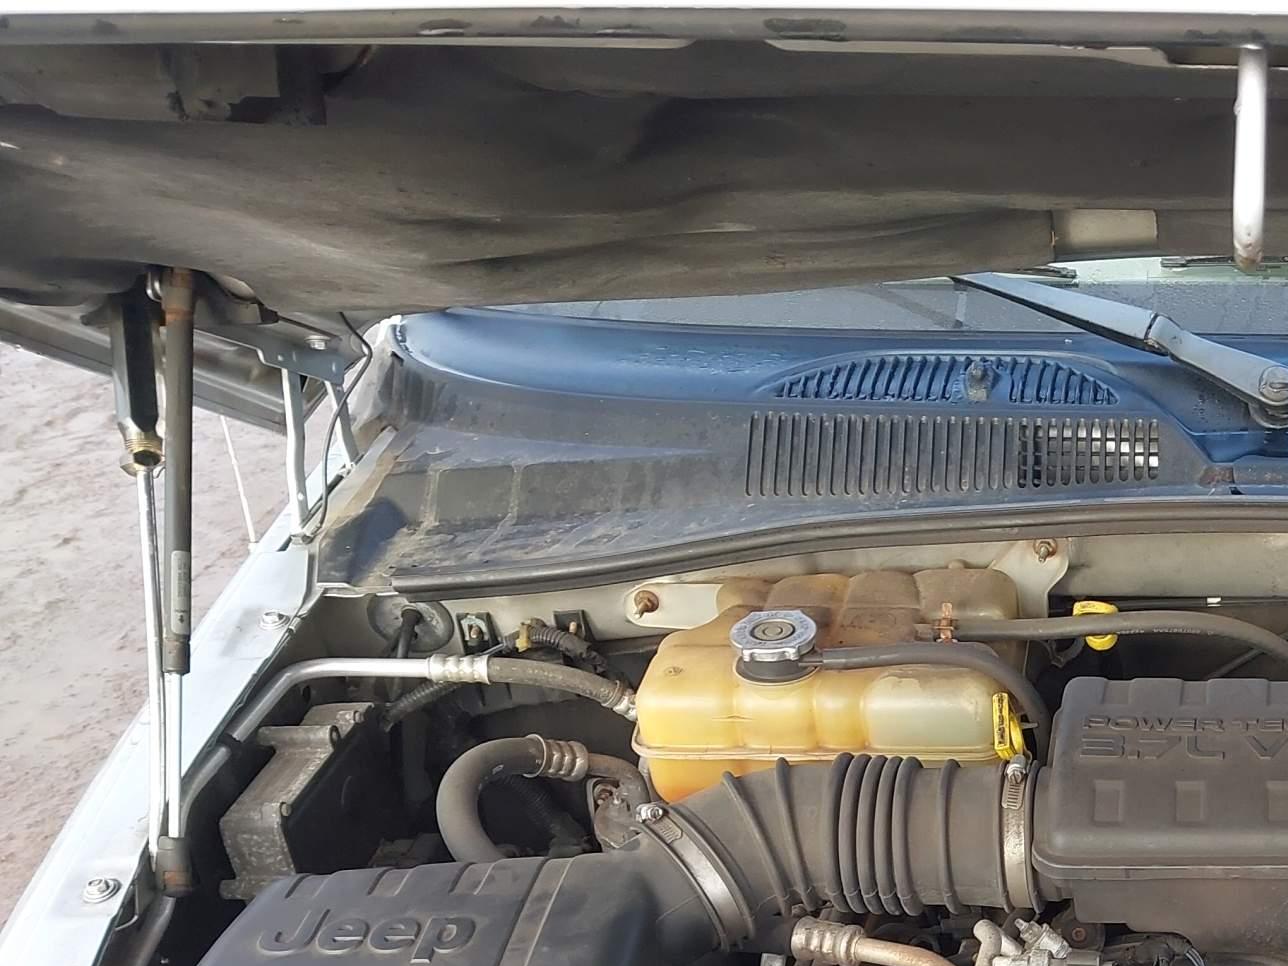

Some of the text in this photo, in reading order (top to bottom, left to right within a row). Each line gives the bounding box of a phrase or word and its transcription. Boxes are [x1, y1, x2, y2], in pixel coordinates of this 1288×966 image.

[1083, 714, 1225, 733] POWER
[1079, 734, 1226, 761] 3.7L
[256, 909, 477, 963] Jeep
